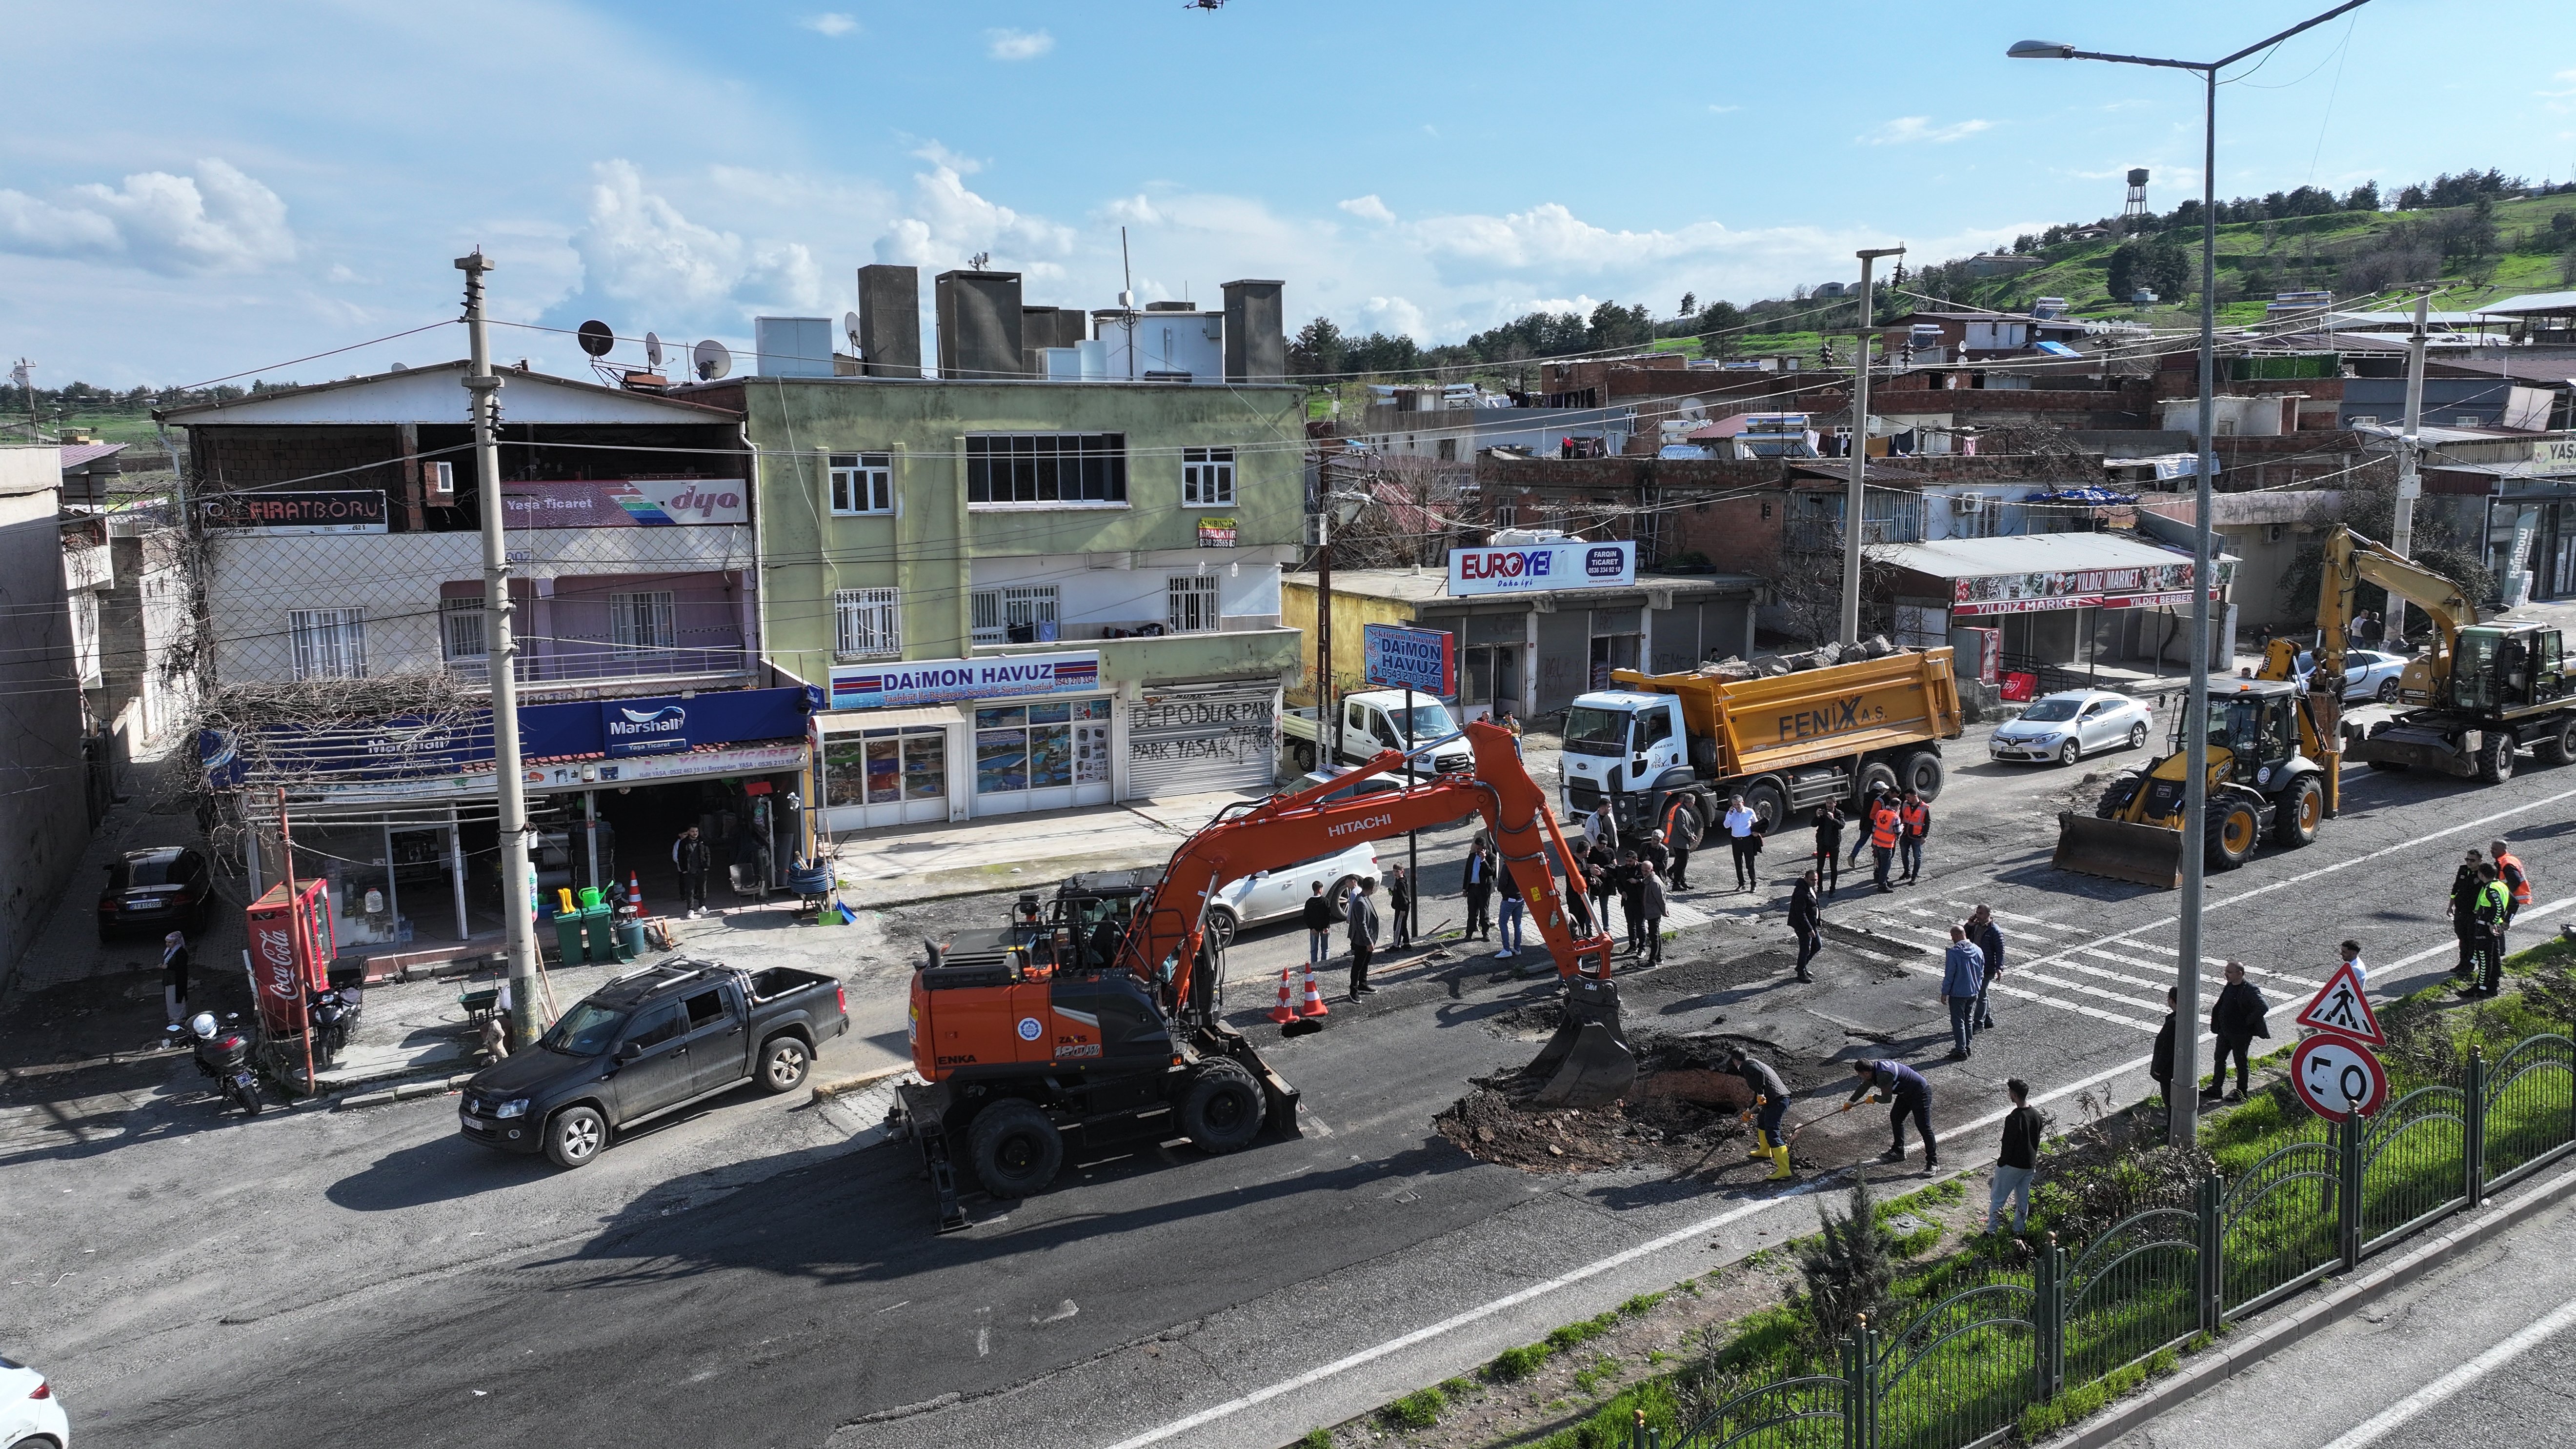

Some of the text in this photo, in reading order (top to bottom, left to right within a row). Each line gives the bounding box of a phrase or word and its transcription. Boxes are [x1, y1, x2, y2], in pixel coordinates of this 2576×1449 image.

[2550, 443, 2576, 463] YAŞ
[506, 498, 593, 511] Yaşa Ticaret
[671, 485, 740, 517] dyo
[1200, 539, 1212, 547] 0538
[2509, 528, 2528, 579] Rainbow
[1497, 578, 1533, 587] Daha iyi
[2077, 569, 2140, 593] YILDIZ MARKET
[1977, 599, 2080, 614] YILDIZ MARKET
[2129, 593, 2193, 607] YILDIZ BERBER
[1408, 632, 1440, 645] Öncüsü
[981, 663, 1053, 684] HAVUZ
[1382, 654, 1441, 676] HAVUZ
[1055, 676, 1097, 687] 0543 270 3347
[1382, 668, 1441, 686] 0543 270 33 47
[883, 692, 917, 704] Taahhüt
[967, 688, 989, 697] Servis
[1025, 683, 1055, 692] Dostluk
[2208, 700, 2231, 710] İSKİ
[1133, 702, 1275, 728] DEPODUR PARK
[610, 718, 679, 735] Marshall
[1133, 742, 1170, 760] PARK
[1176, 737, 1235, 758] YASAK
[2215, 761, 2231, 781] JCB
[1328, 813, 1392, 837] HITACHI
[259, 928, 299, 1000] Coca-Cola
[1058, 1035, 1087, 1044] ZAXIS
[938, 1055, 977, 1065] ENKA
